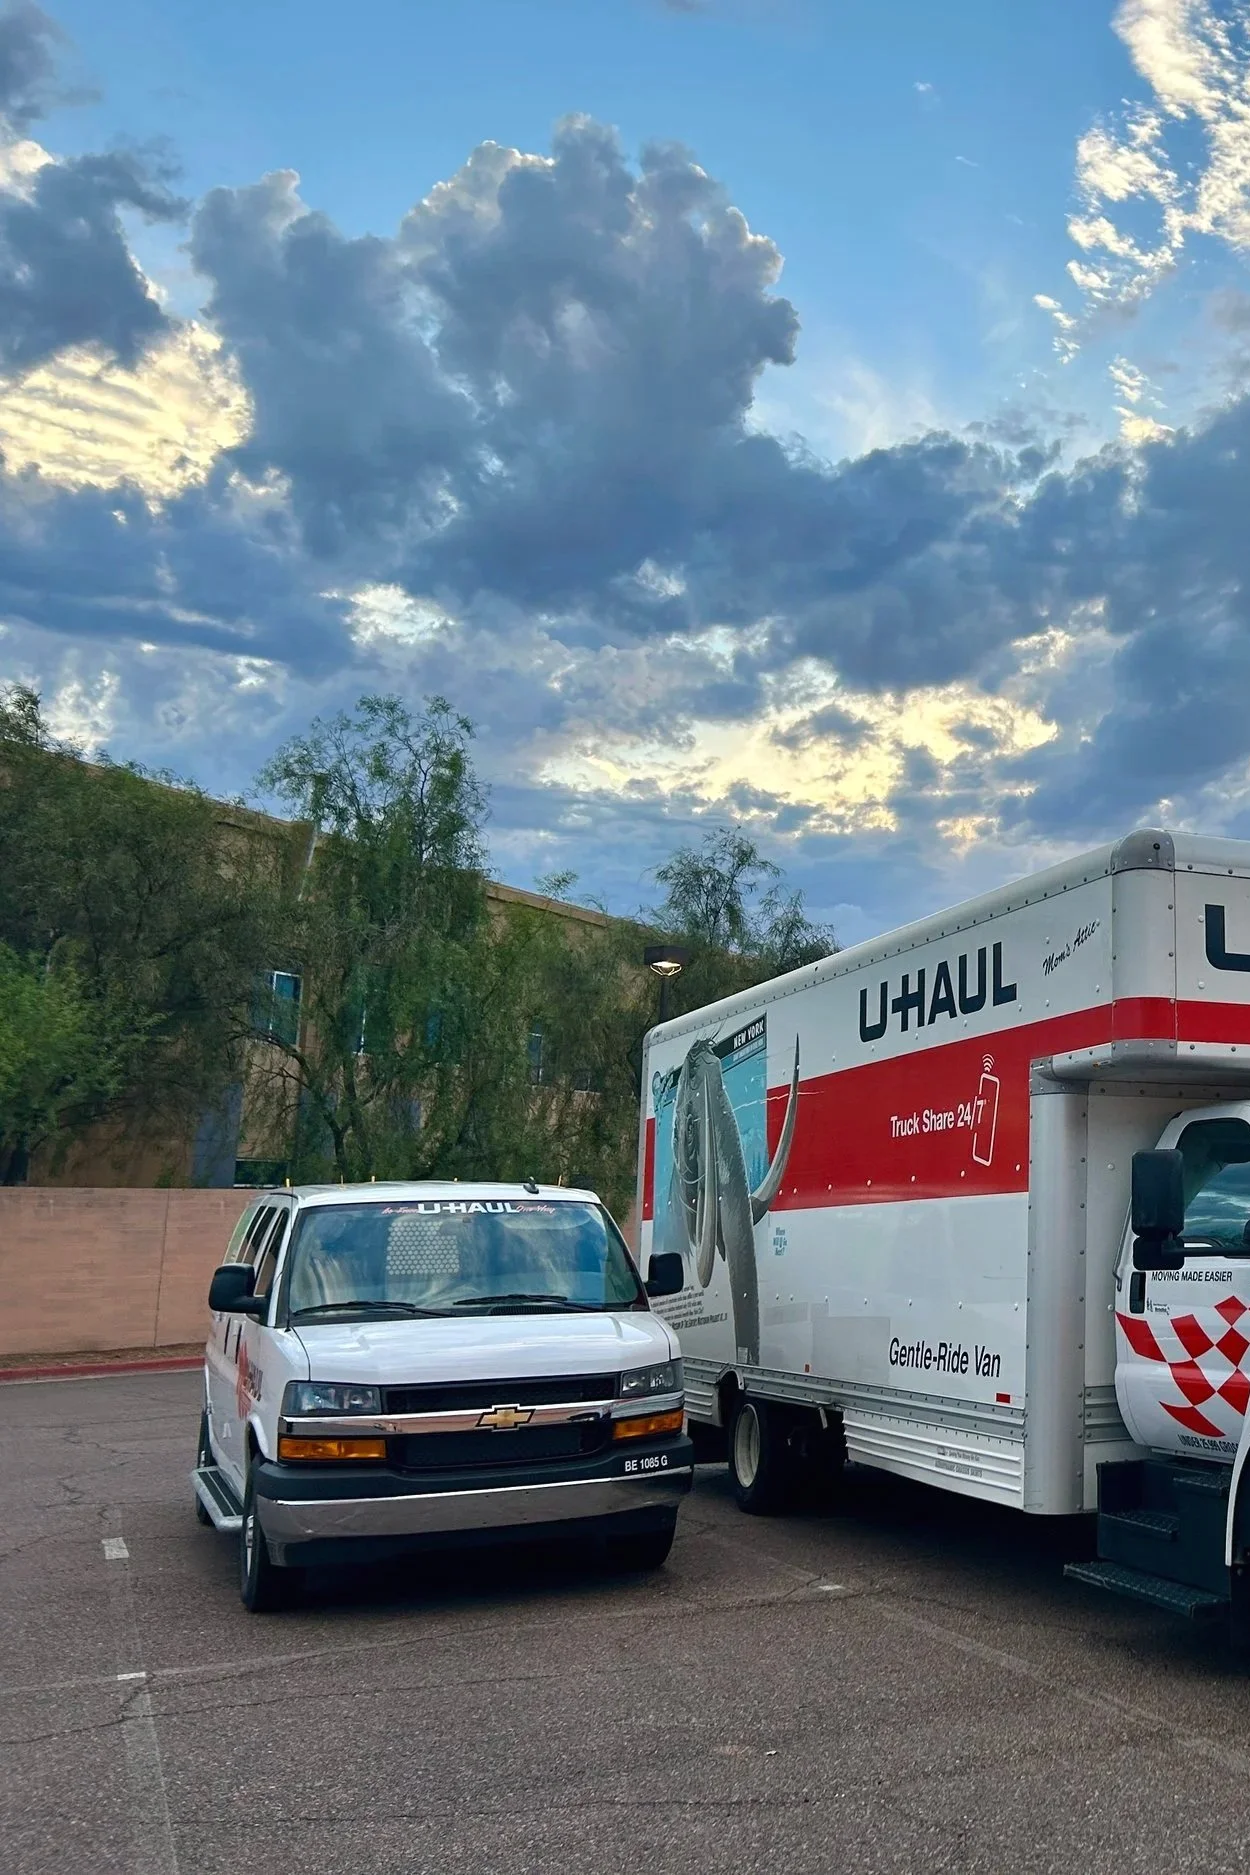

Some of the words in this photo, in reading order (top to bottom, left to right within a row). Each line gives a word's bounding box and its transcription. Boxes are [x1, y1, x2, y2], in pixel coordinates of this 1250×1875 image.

[859, 941, 1017, 1042] U-HAUL
[733, 1030, 748, 1049] NEW
[748, 1020, 764, 1039] YORK
[890, 1112, 920, 1138] Truck
[922, 1109, 955, 1133] Share
[957, 1095, 984, 1131] 24/7
[417, 1202, 519, 1214] U-HAUL
[1151, 1271, 1180, 1281] MOVING
[1181, 1271, 1203, 1282] MADE
[1204, 1271, 1233, 1282] EASIER
[889, 1337, 969, 1375] Gentle-Ride
[974, 1344, 1001, 1378] Van
[625, 1459, 638, 1472] BE
[660, 1455, 668, 1466] G
